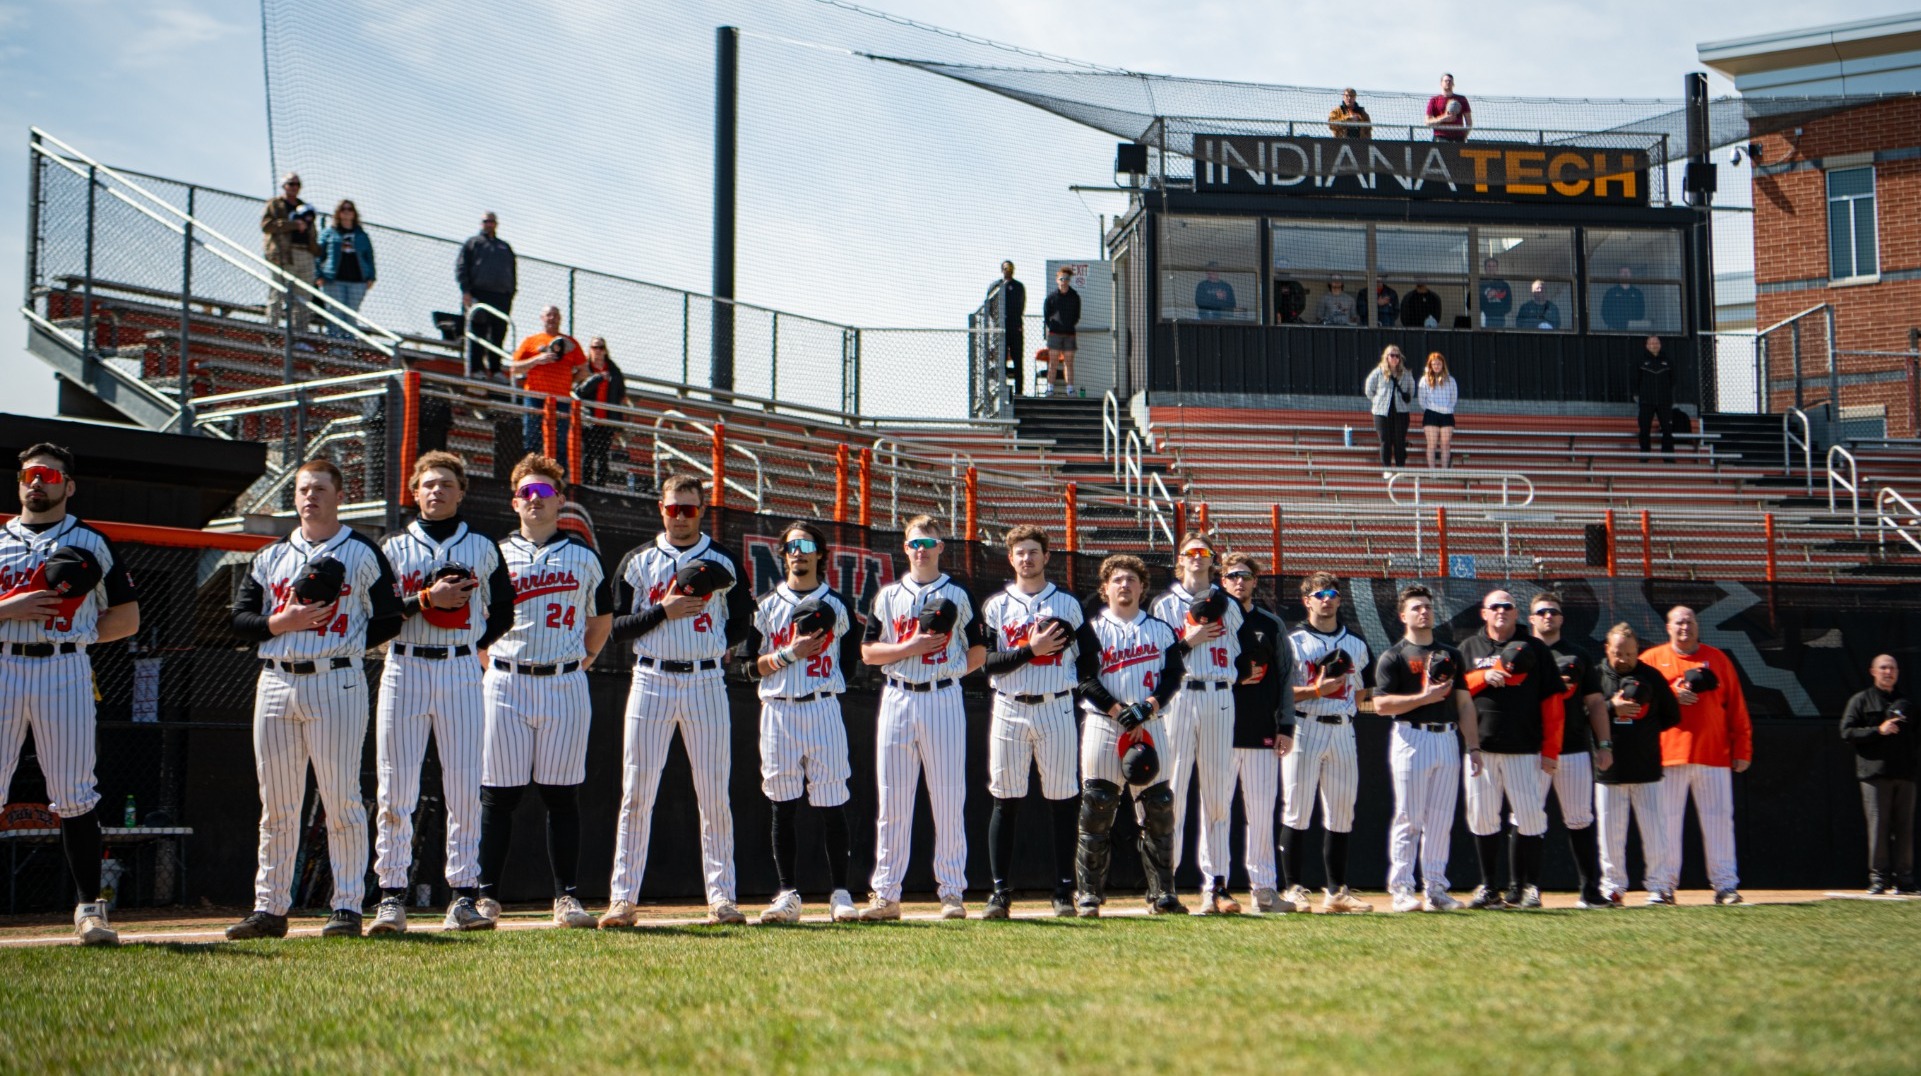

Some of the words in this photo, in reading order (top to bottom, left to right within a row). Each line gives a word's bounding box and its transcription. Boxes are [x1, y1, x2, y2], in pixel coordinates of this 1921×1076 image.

[1204, 139, 1457, 192] INDIANA
[1459, 148, 1637, 199] TECH
[546, 603, 575, 631] 24
[807, 655, 832, 678] 20
[1100, 642, 1159, 669] Warriors
[1209, 647, 1228, 668] 16
